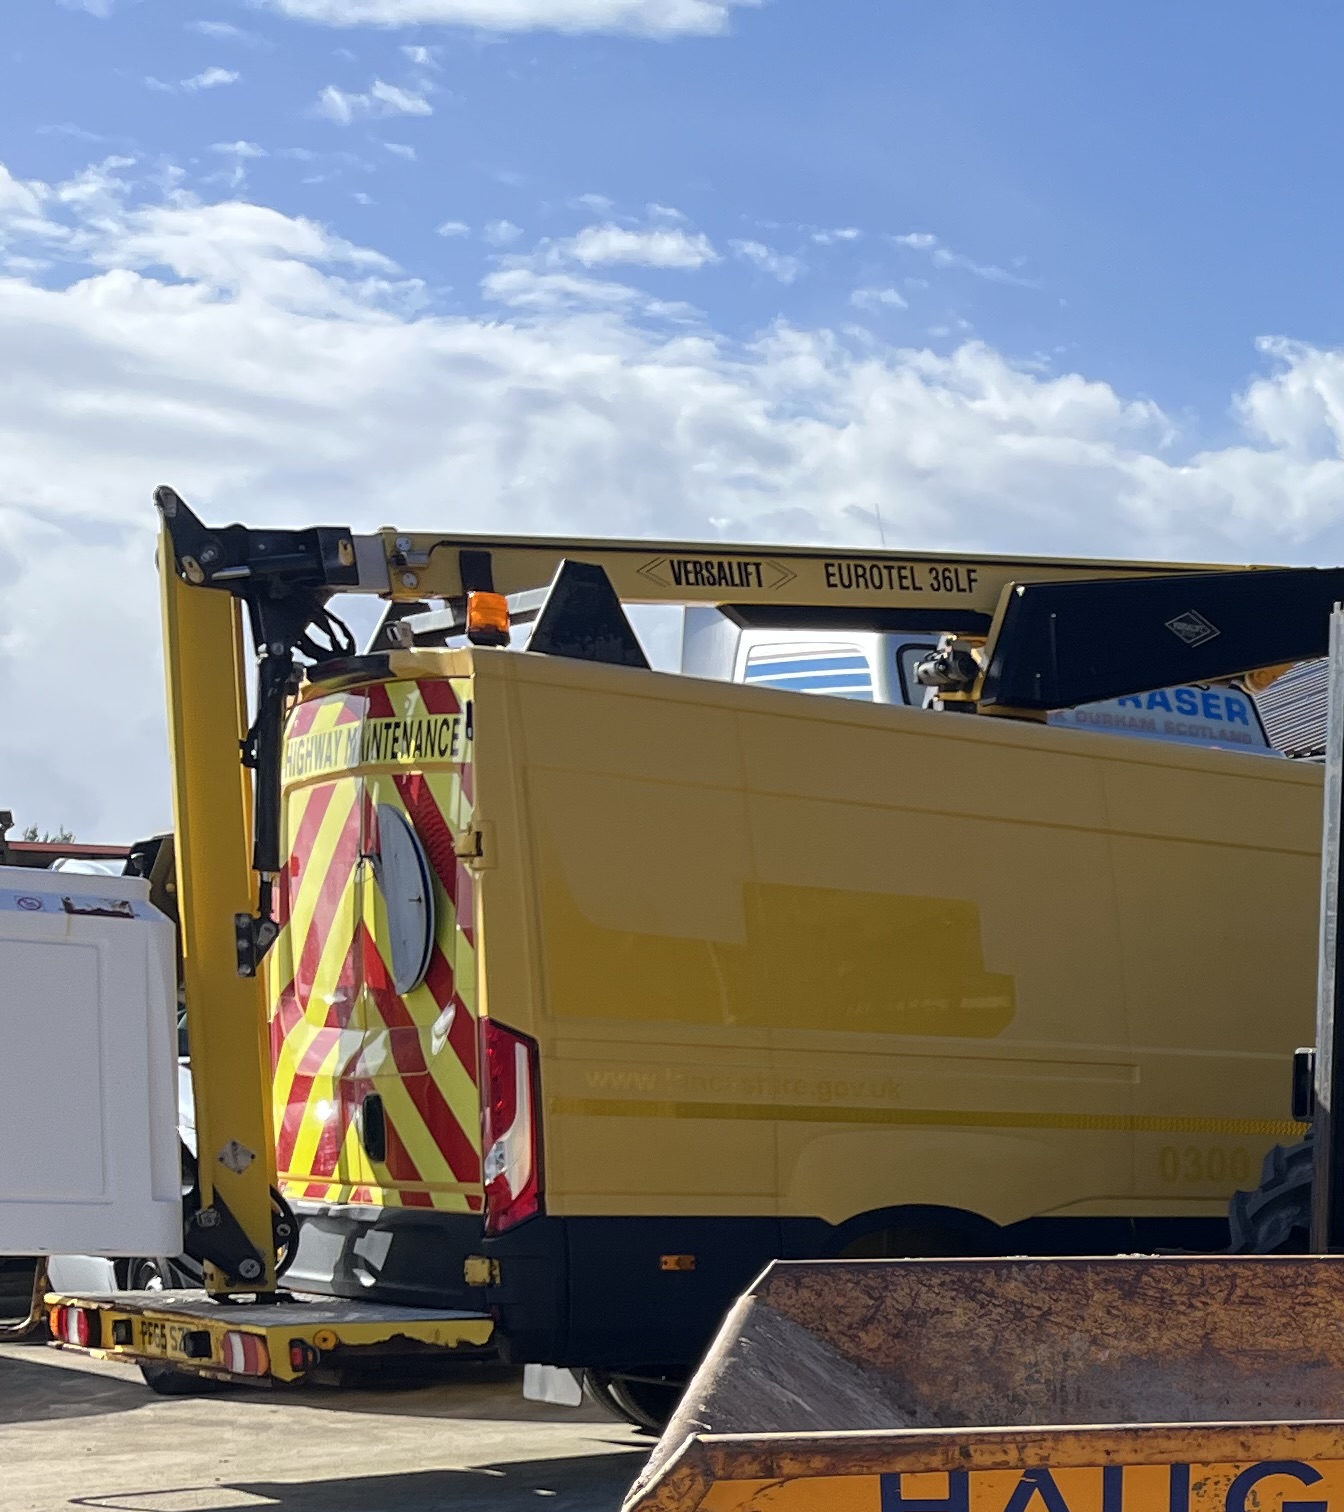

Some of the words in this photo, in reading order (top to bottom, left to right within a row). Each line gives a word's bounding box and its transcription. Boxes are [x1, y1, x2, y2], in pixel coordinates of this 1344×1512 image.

[669, 559, 763, 588] VERSALIFT
[824, 562, 923, 591] EUROTEL
[929, 567, 977, 593] 36LF
[286, 729, 343, 778] HIGHWAY
[346, 718, 460, 770] MAINTENANCE
[1163, 721, 1253, 744] SCOTLAND
[1158, 1145, 1249, 1183] 0300
